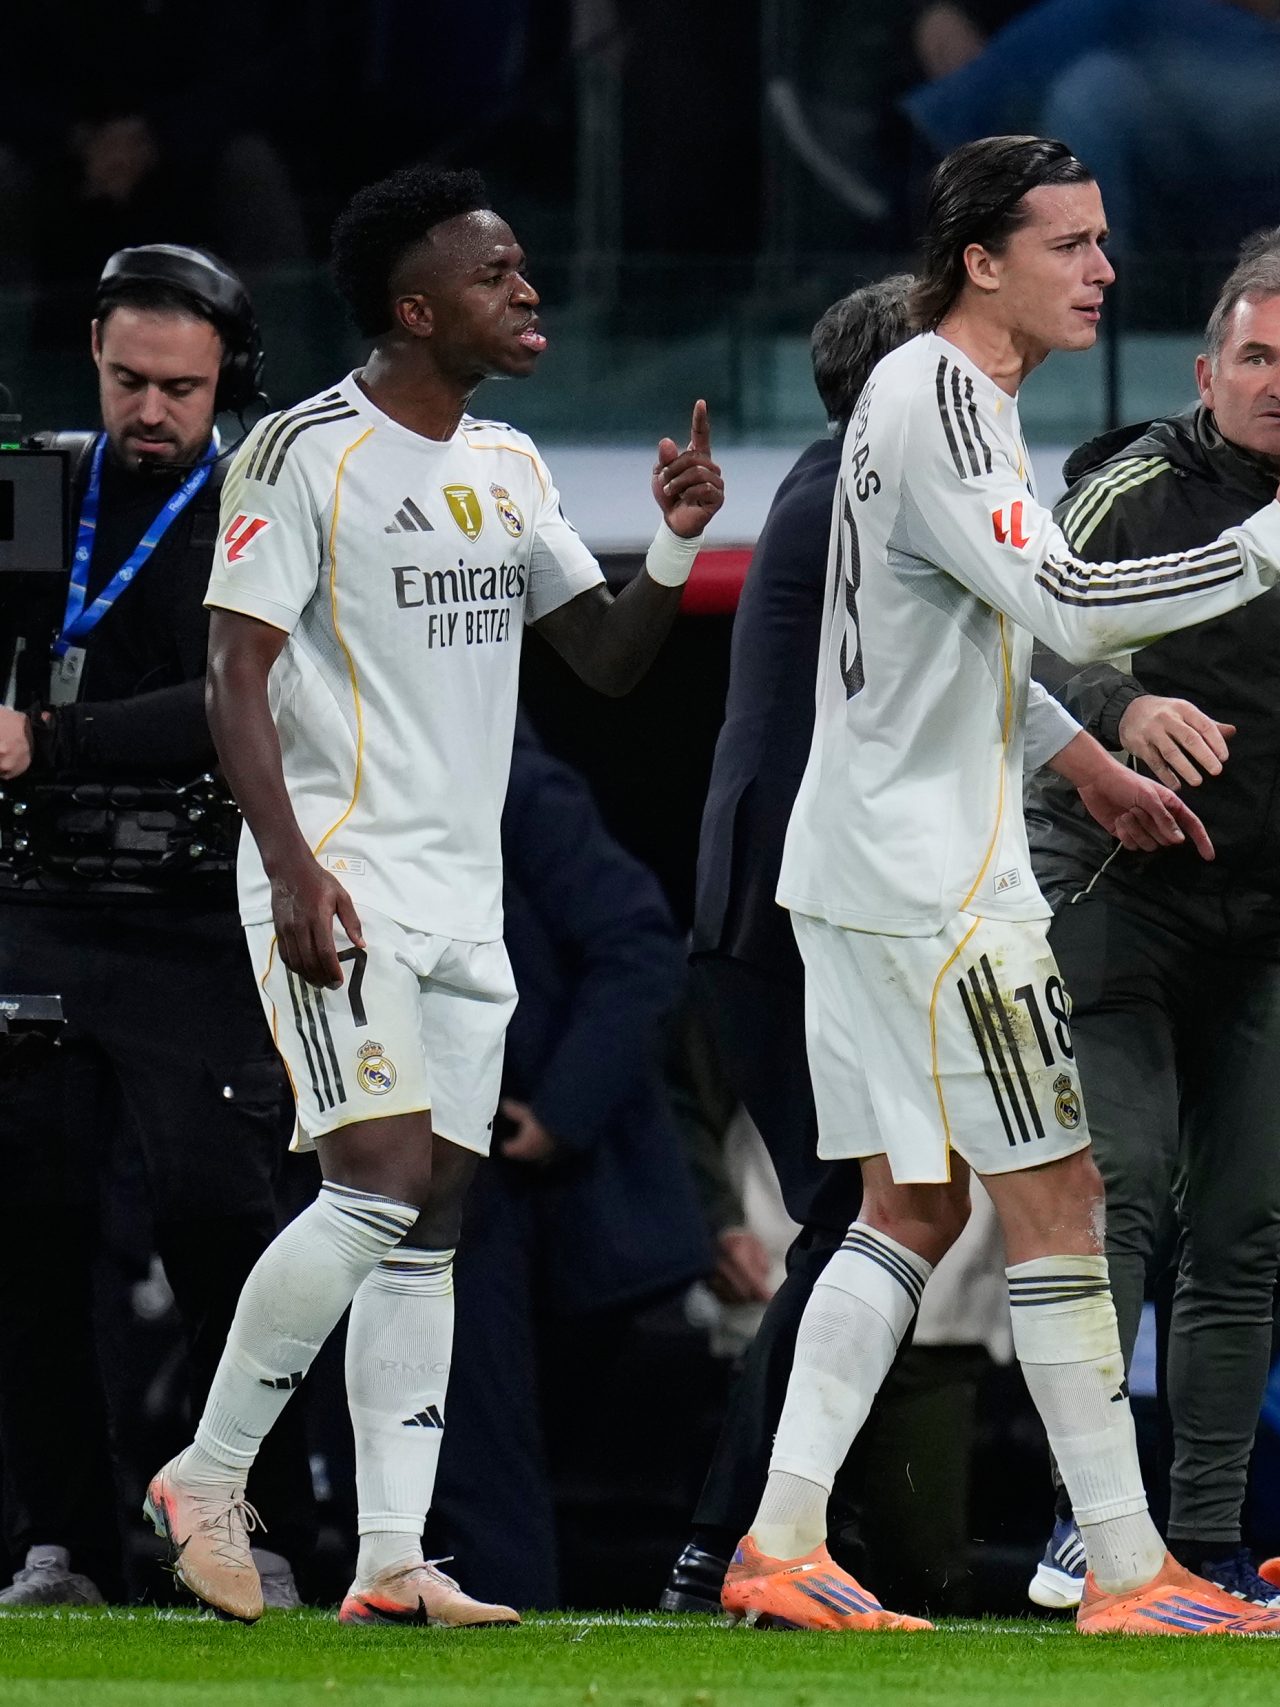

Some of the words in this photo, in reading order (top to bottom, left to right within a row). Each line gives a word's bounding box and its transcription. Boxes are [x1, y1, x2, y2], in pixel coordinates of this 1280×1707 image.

[391, 558, 526, 609] Emirates
[428, 611, 459, 649] FLY
[466, 607, 511, 645] BETTER
[337, 947, 368, 1028] 7
[1014, 975, 1074, 1068] 18
